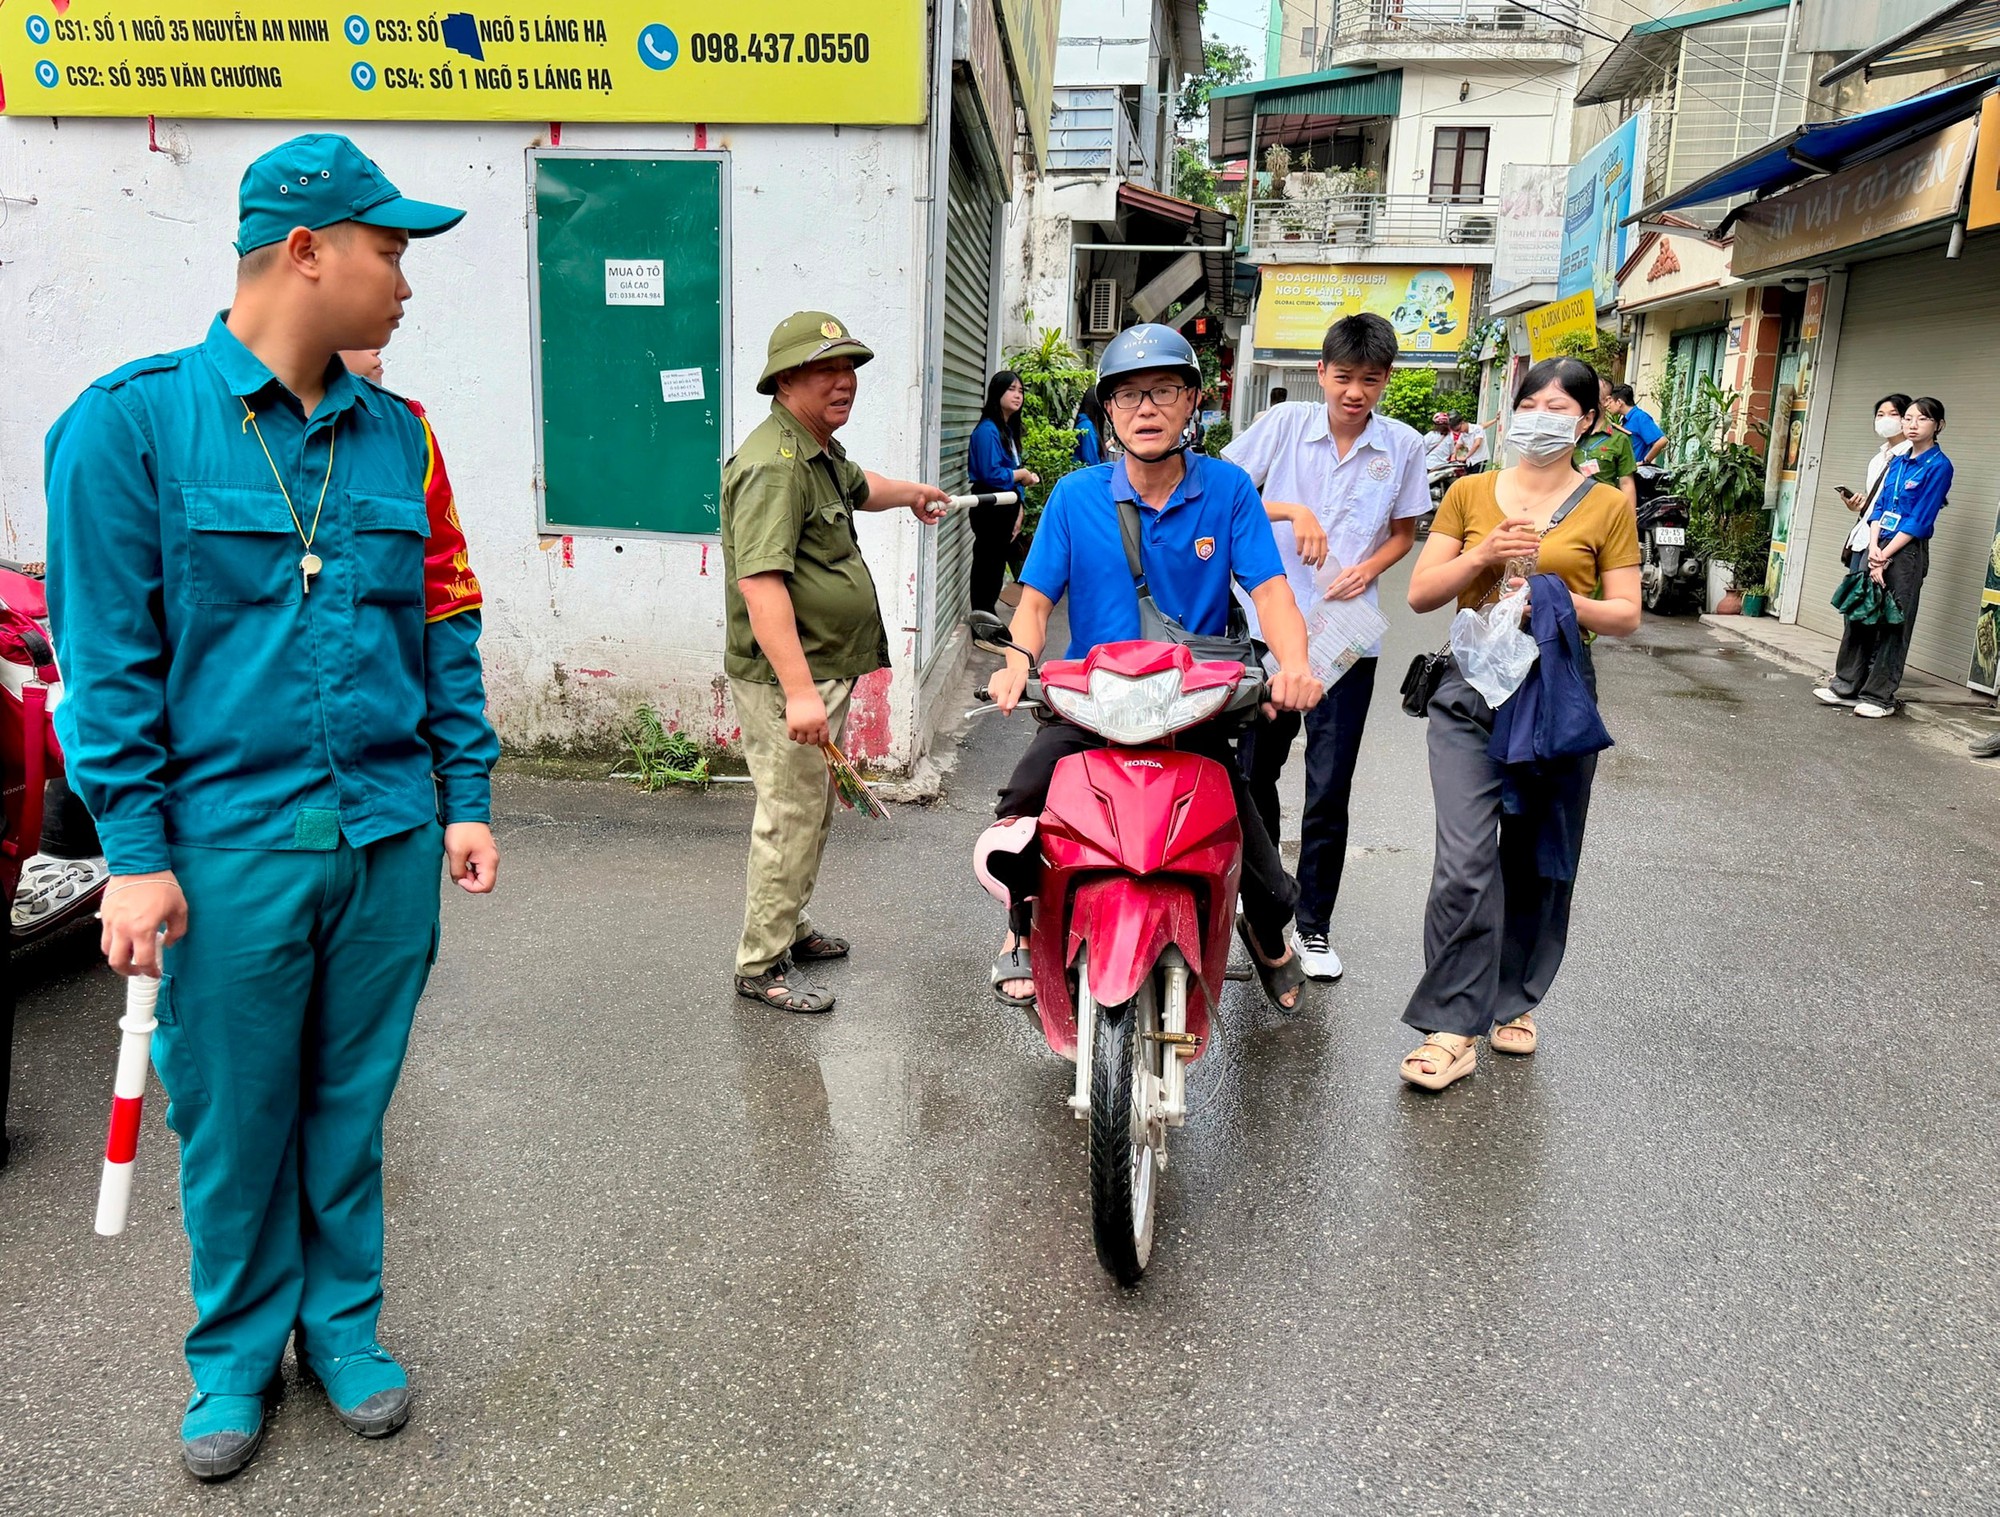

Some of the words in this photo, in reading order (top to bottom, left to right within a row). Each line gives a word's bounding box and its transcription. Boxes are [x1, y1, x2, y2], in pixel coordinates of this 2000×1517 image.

[55, 19, 91, 41] CS1:
[93, 12, 115, 41] SỐ
[118, 20, 128, 41] 1
[132, 16, 165, 41] NGÕ
[169, 20, 189, 41] 35
[192, 11, 257, 42] NGUYỄN
[262, 20, 285, 42] AN
[288, 20, 330, 42] NINH
[375, 19, 413, 42] CS3:
[417, 12, 439, 42] SỐ
[479, 15, 515, 42] NGÕ
[519, 20, 530, 42] 5
[534, 15, 579, 42] LÁNG
[584, 20, 608, 47] HẠ
[690, 32, 870, 64] 098.437.0550
[66, 66, 105, 87] CS2:
[108, 59, 132, 87] SỐ
[135, 66, 167, 87] 395
[170, 62, 207, 87] VĂN
[210, 65, 282, 88] CHƯƠNG
[384, 67, 424, 89] CS4:
[430, 60, 453, 89] SỐ
[458, 68, 468, 89] 1
[474, 63, 513, 90] NGÕ
[517, 68, 529, 90] 5
[534, 63, 582, 90] LÁNG
[587, 68, 613, 95] HẠ
[608, 267, 634, 277] MUA
[636, 264, 644, 277] Ô
[646, 264, 660, 277] TÔ
[1276, 272, 1339, 283] COACHING
[1341, 274, 1388, 285] ENGLISH
[620, 280, 633, 289] GIÁ
[634, 281, 649, 289] CAO
[1124, 339, 1159, 349] VINFAST
[1123, 759, 1164, 769] HONDA
